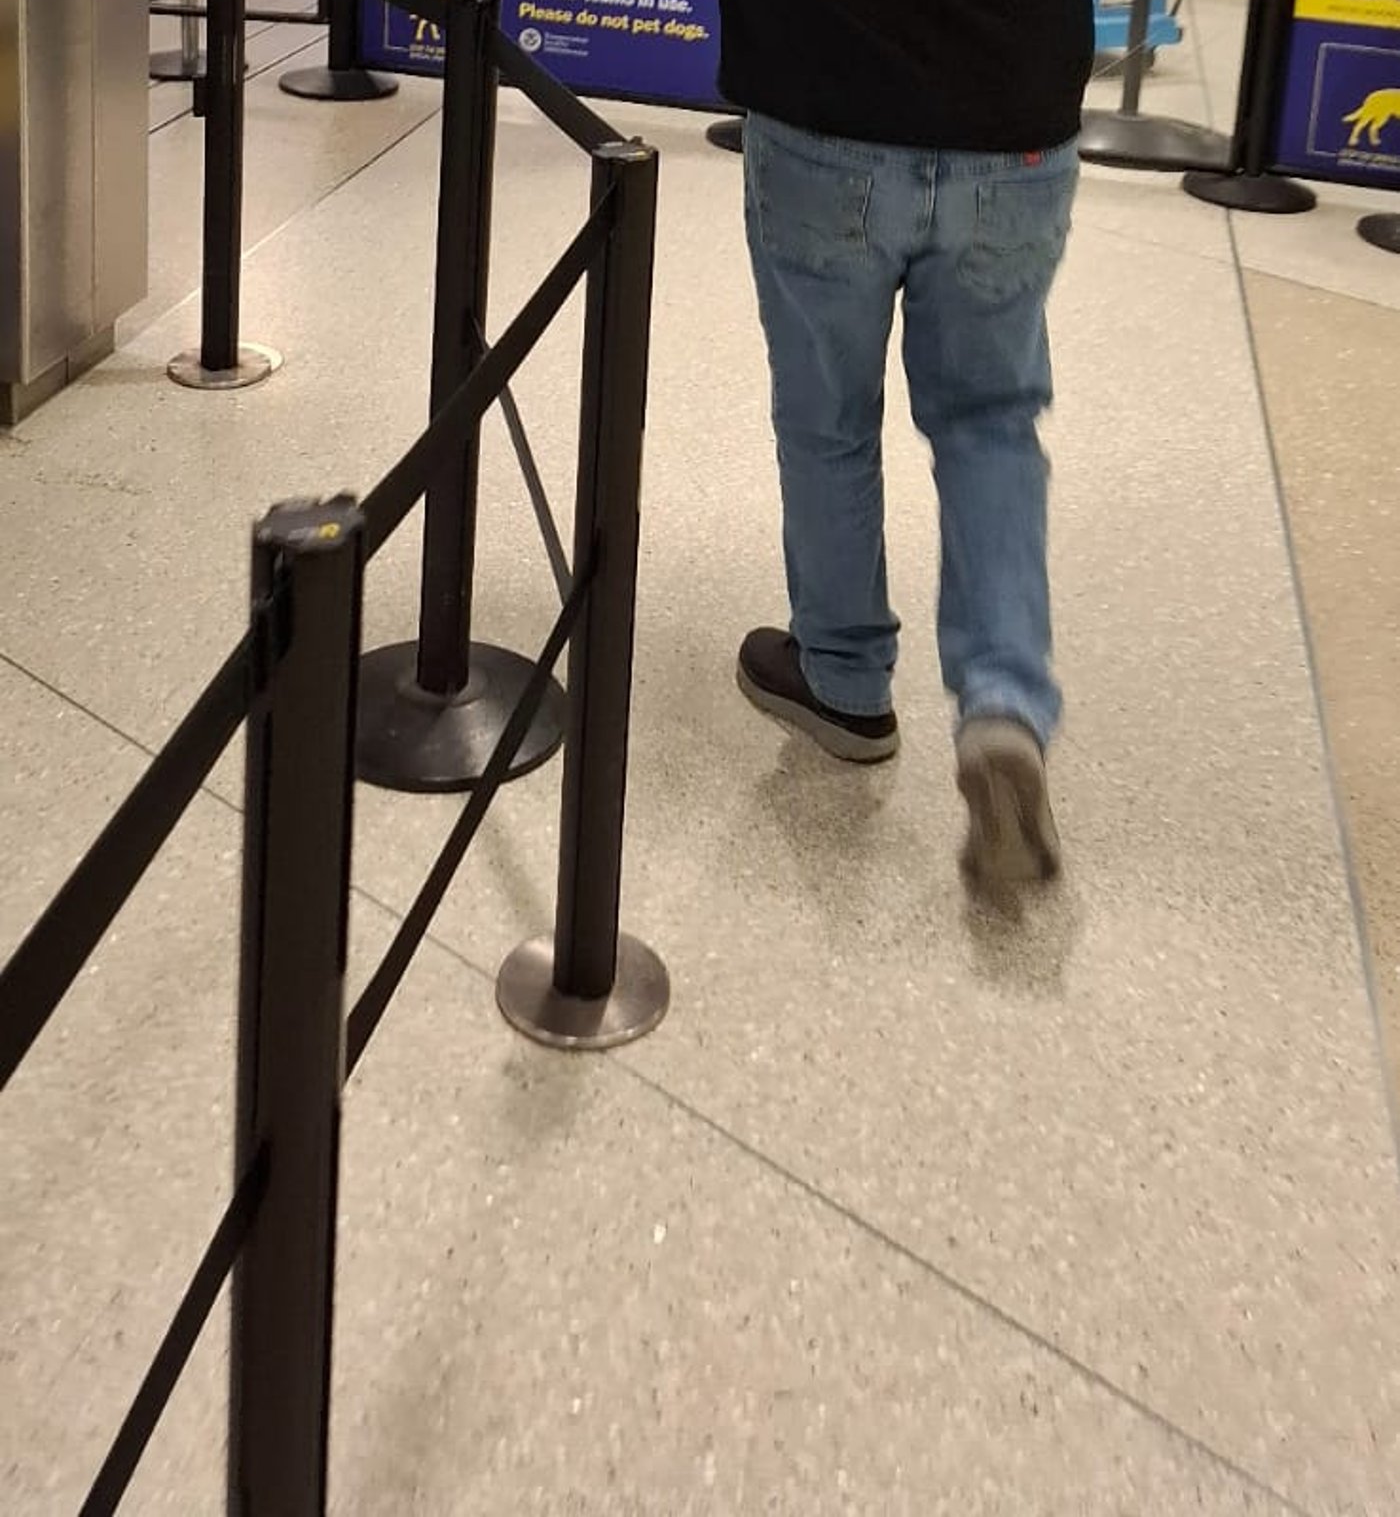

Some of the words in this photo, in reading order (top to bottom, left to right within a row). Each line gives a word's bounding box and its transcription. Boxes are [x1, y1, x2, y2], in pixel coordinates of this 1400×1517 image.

[519, 2, 573, 23] Please
[576, 8, 598, 27] do
[601, 13, 629, 31] not
[632, 17, 661, 35] pet
[664, 19, 711, 41] dogs.
